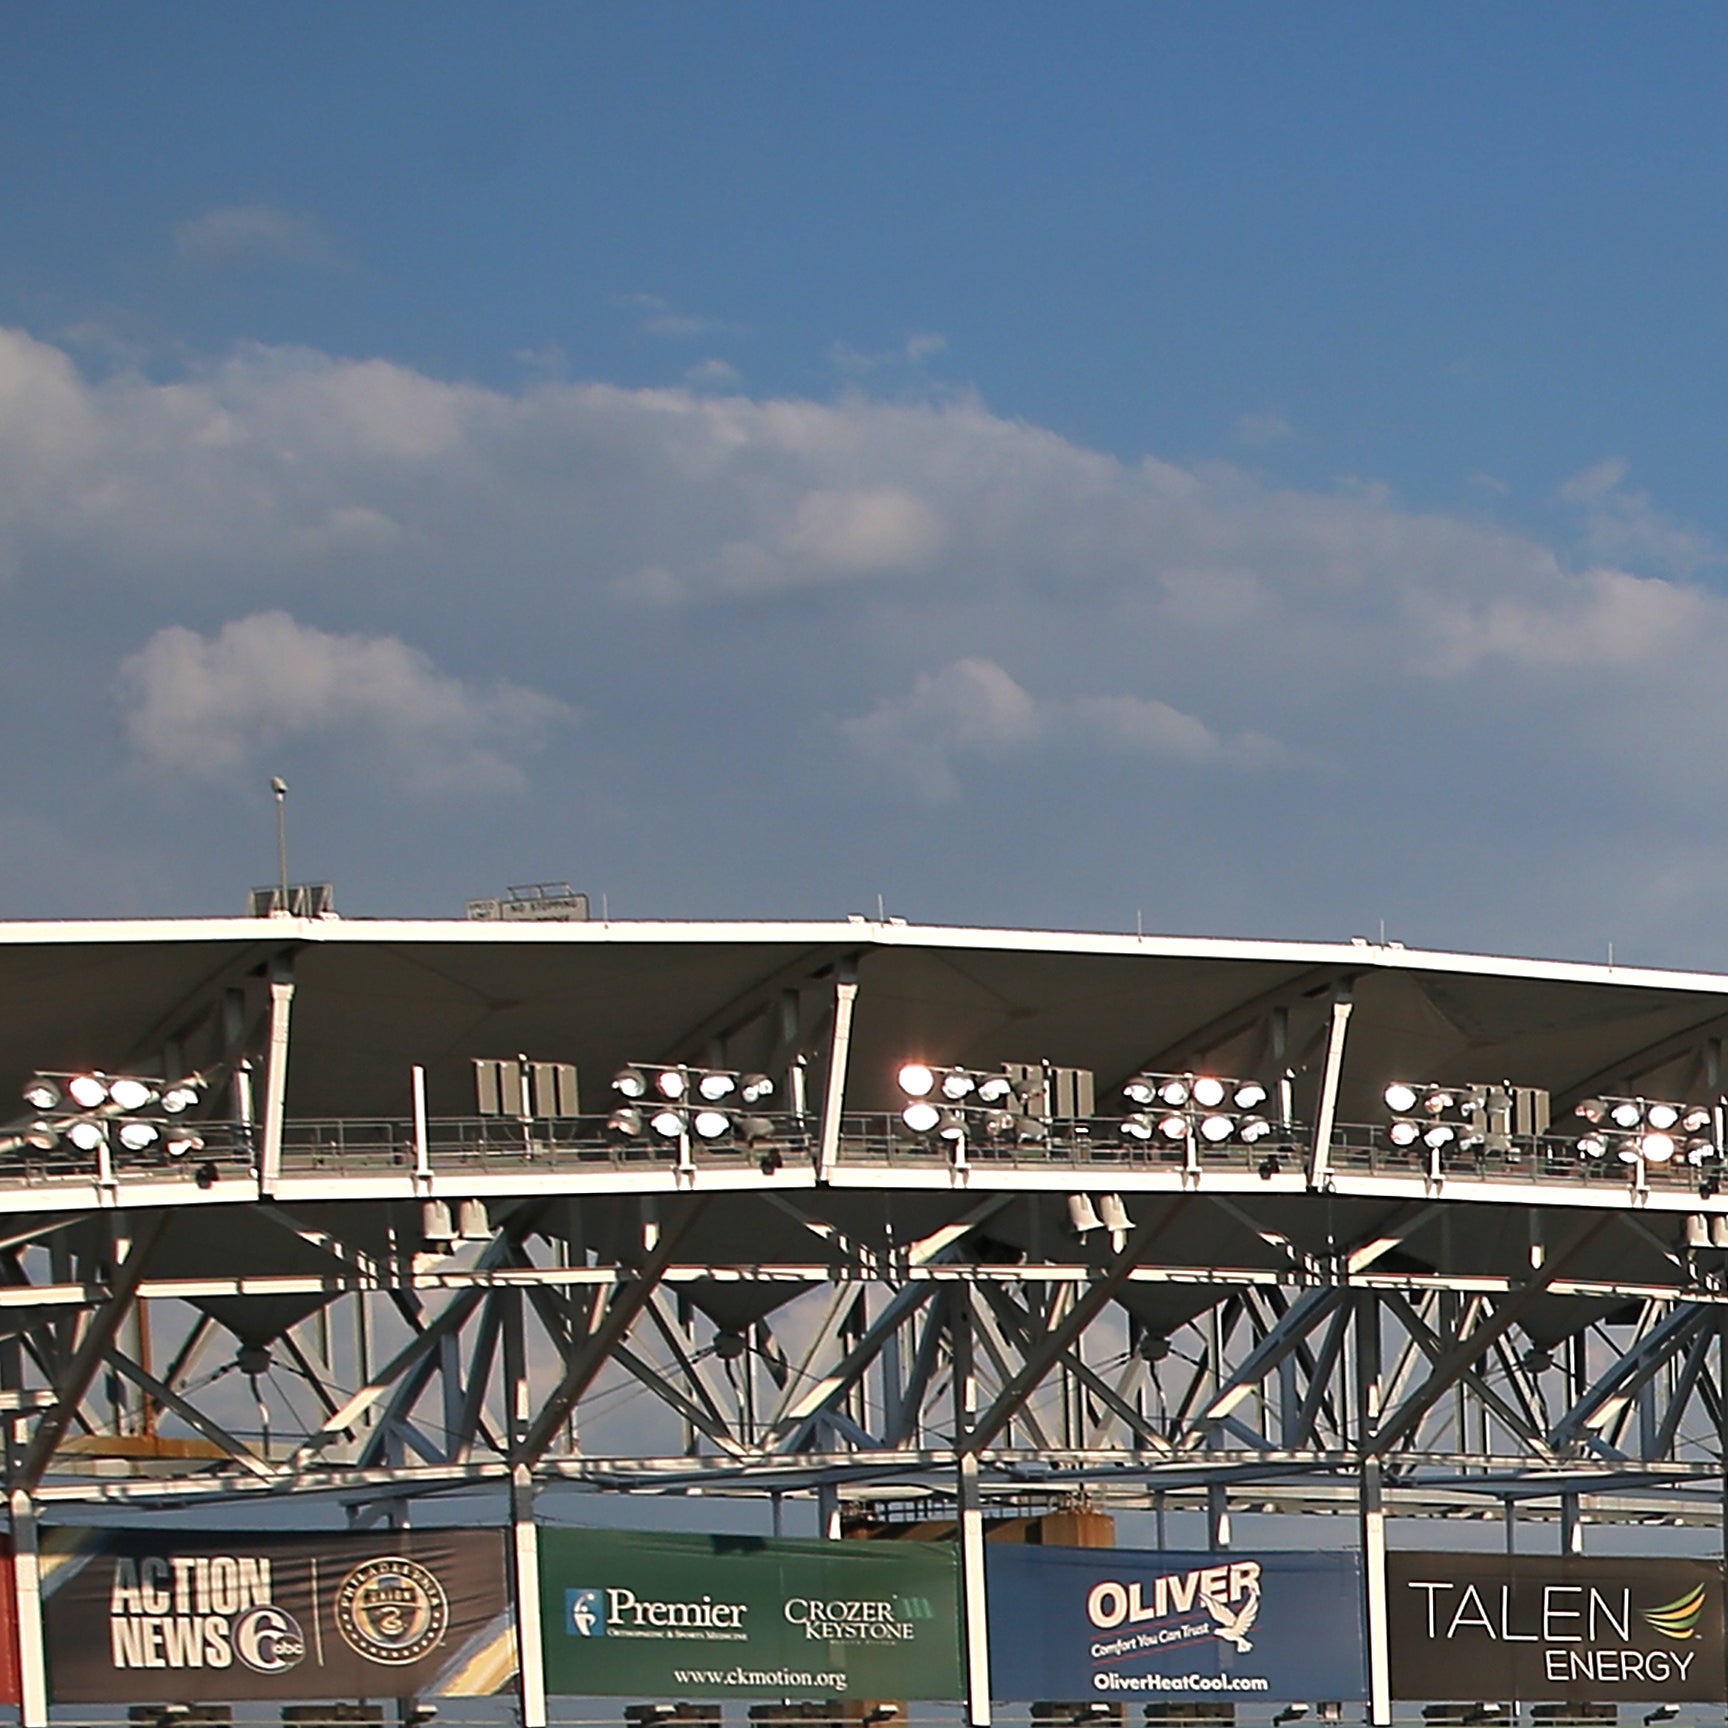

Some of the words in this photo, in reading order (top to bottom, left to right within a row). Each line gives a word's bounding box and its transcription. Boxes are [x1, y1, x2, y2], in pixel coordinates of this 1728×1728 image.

[110, 1557, 272, 1614] ACTION
[341, 1562, 440, 1607] PHILADELPHIA
[1087, 1560, 1262, 1628] OLIVER
[606, 1588, 748, 1628] Premier
[784, 1598, 896, 1625] CROZER
[1408, 1582, 1630, 1642] TALEN
[111, 1616, 234, 1668] NEWS
[238, 1611, 290, 1669] 6
[272, 1635, 304, 1656] abc
[805, 1622, 915, 1641] KEYSTONE
[1091, 1638, 1138, 1658] Comfort
[1137, 1633, 1159, 1648] You
[1158, 1629, 1182, 1643] Can
[1181, 1622, 1210, 1638] Trust
[674, 1667, 848, 1691] www.ckmotion.org
[1093, 1672, 1269, 1691] OliverHeatCool.com
[1545, 1649, 1695, 1681] ENERGY
